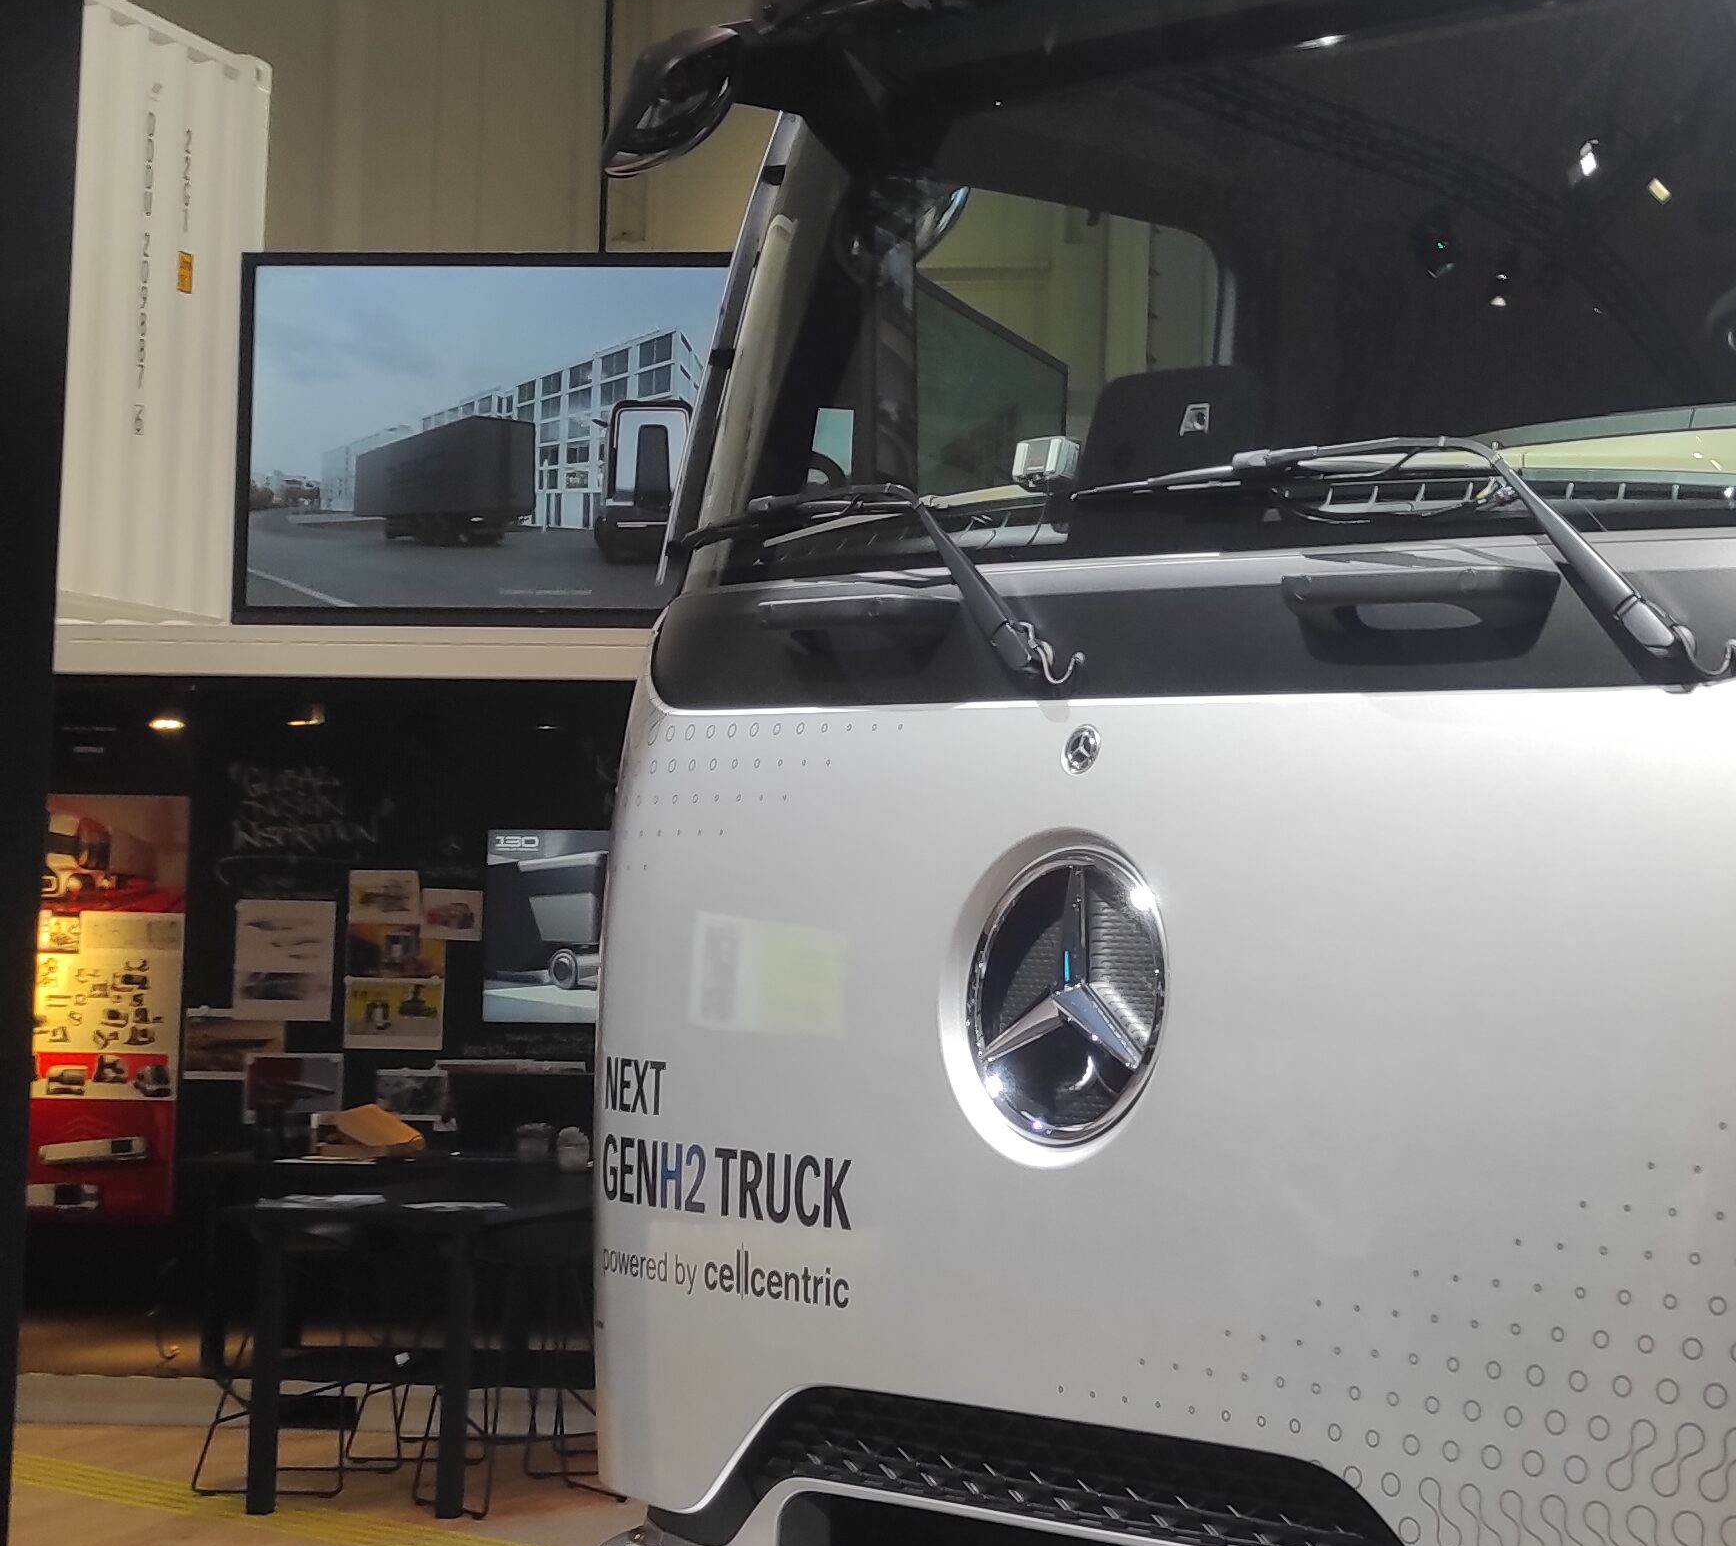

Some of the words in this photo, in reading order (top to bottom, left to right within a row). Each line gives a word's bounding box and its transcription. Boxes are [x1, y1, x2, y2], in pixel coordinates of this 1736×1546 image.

[604, 1056, 667, 1116] NEXT
[602, 1133, 706, 1214] GENH2
[714, 1147, 852, 1231] TRUCK
[602, 1248, 668, 1283] powered
[674, 1254, 698, 1295] by
[703, 1242, 850, 1309] cellcentric
